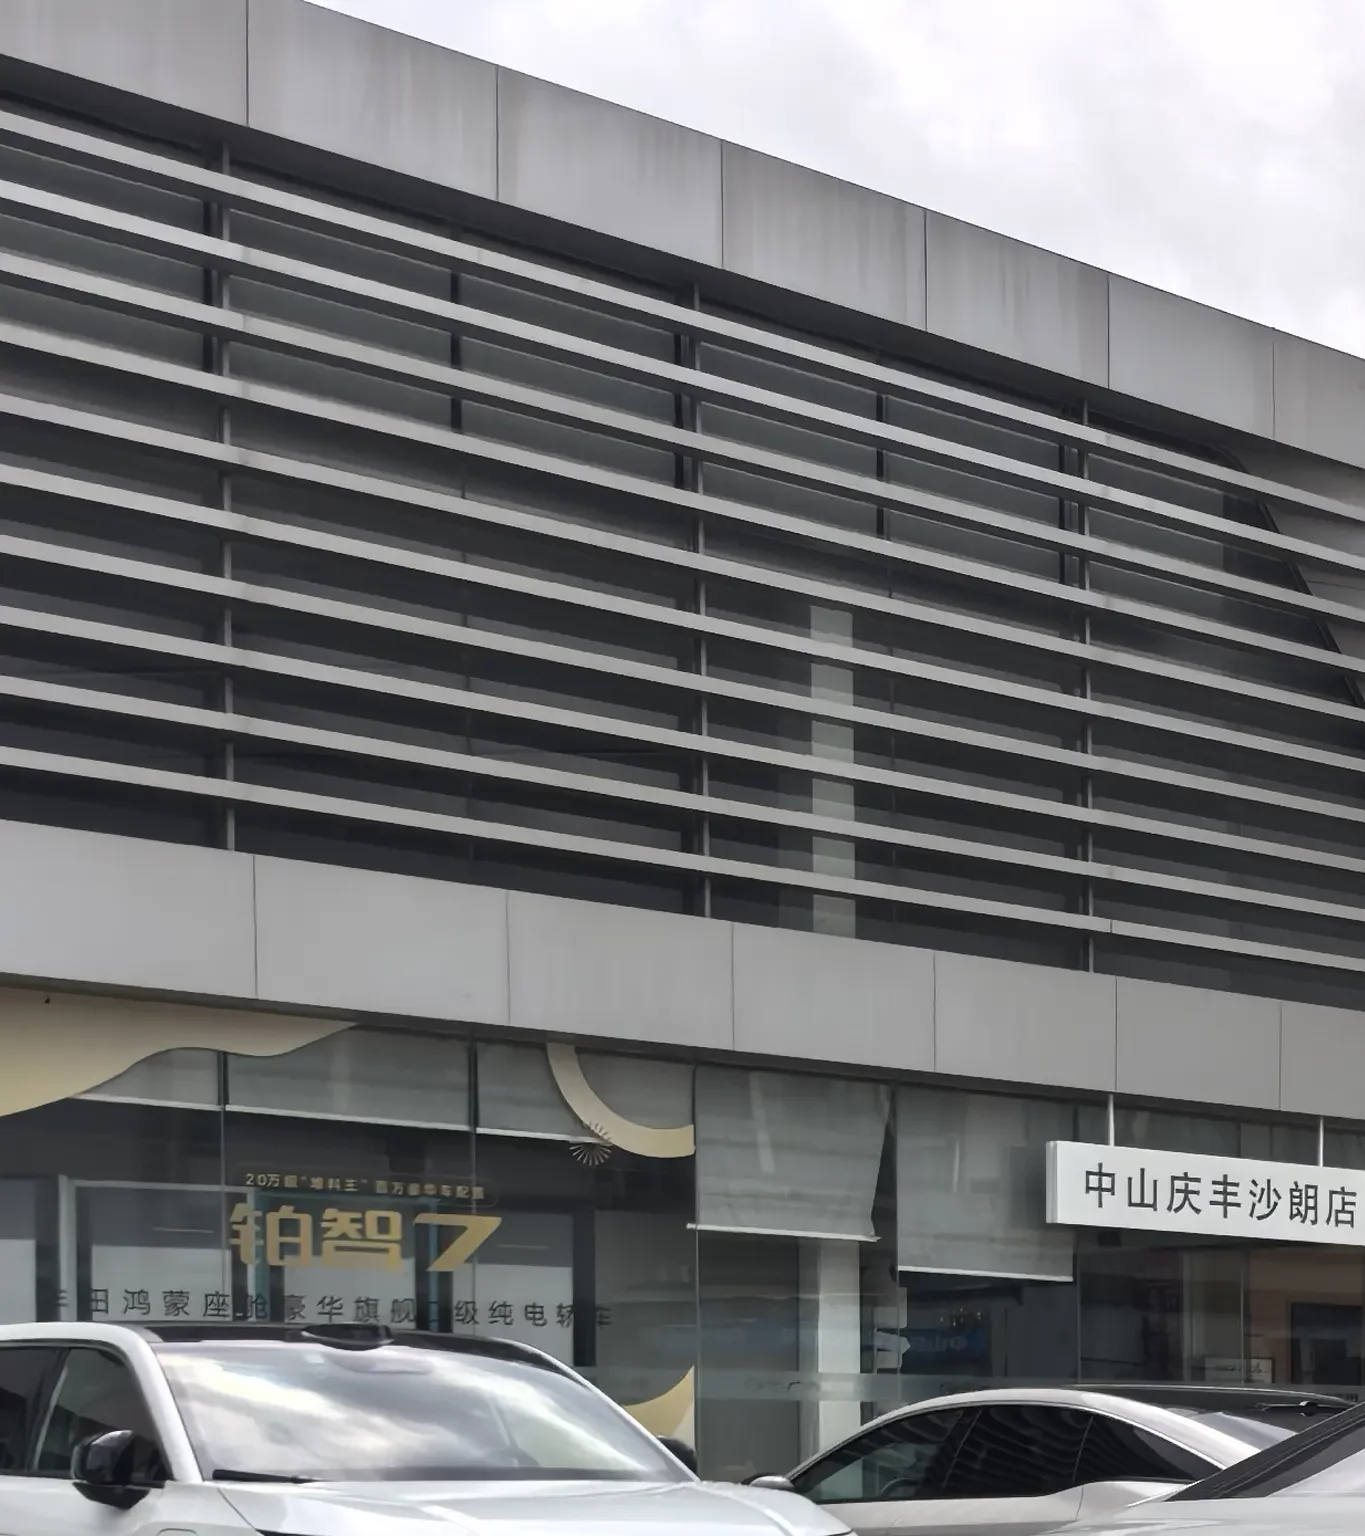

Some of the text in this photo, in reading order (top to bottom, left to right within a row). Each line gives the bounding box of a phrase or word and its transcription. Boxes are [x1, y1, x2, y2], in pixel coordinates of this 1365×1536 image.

[1084, 1162, 1358, 1229] 中山庆丰沙朗店
[229, 1200, 502, 1272] 铂智7
